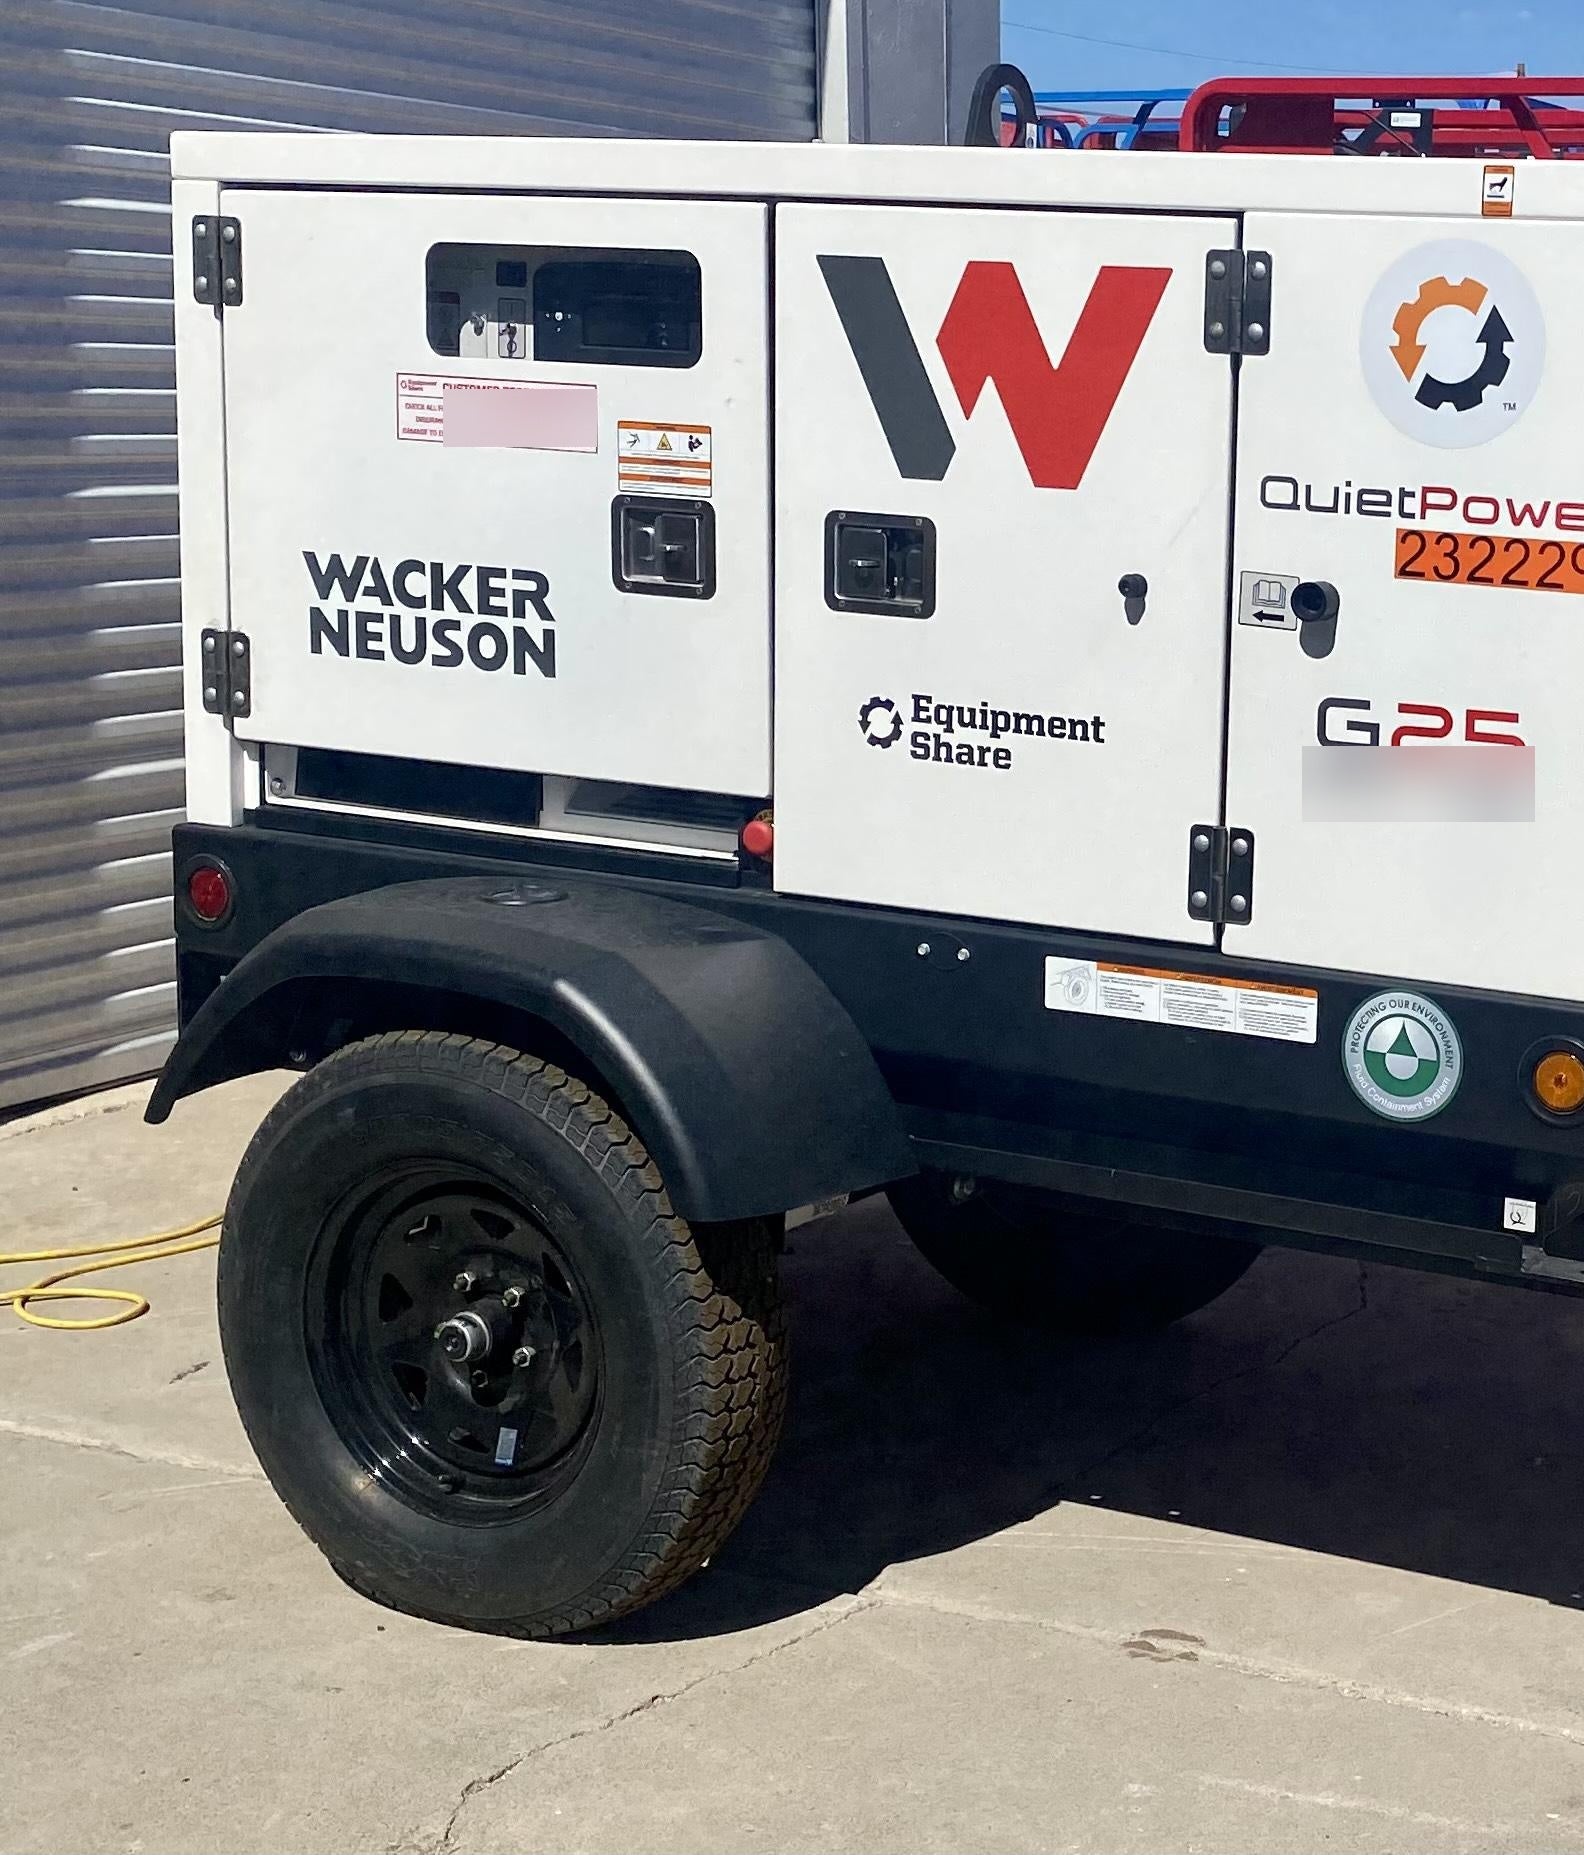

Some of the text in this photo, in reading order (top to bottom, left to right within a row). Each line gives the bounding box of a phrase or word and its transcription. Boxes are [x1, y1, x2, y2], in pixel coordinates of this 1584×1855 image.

[1503, 402, 1517, 411] TM
[302, 551, 556, 622] WACKER
[309, 606, 557, 679] NEUSON
[910, 693, 1106, 744] Equipment
[1317, 697, 1526, 746] G25
[910, 731, 1013, 770] Share
[1351, 999, 1454, 1070] PROTECTING OUR ENVIRONMENT
[1367, 1087, 1424, 1113] Containment
